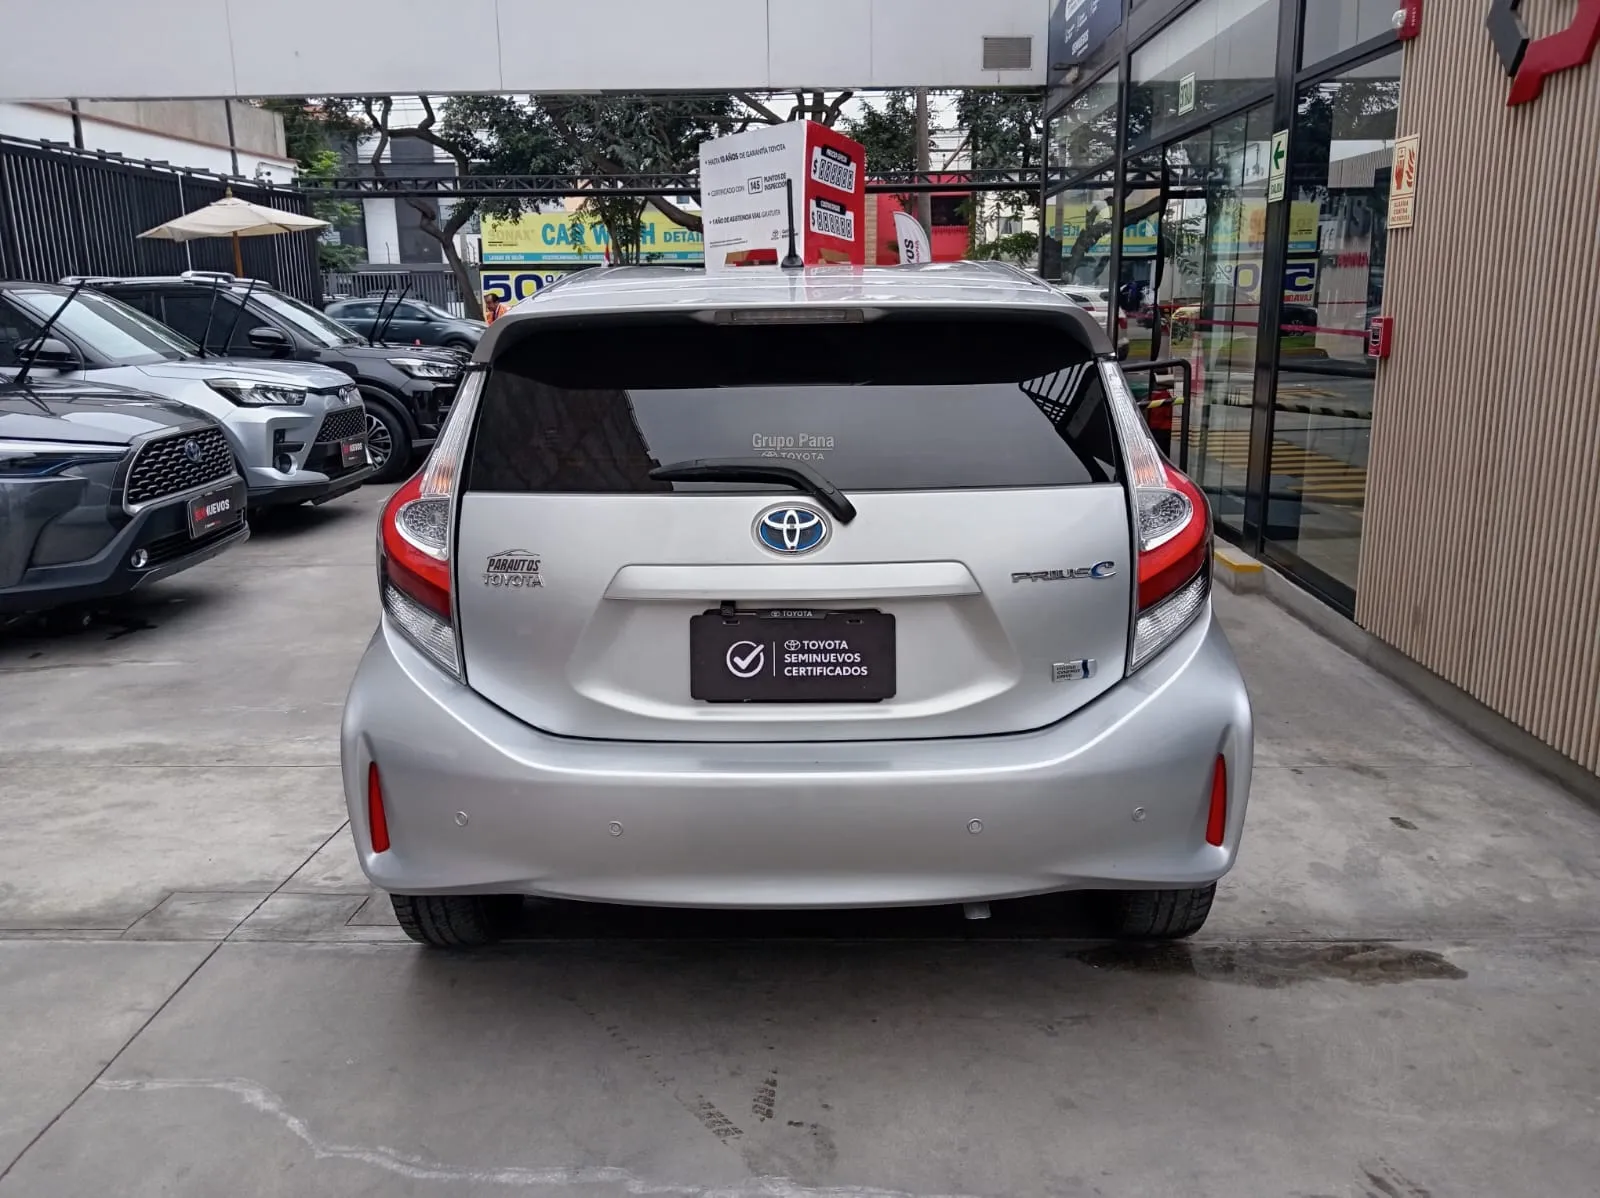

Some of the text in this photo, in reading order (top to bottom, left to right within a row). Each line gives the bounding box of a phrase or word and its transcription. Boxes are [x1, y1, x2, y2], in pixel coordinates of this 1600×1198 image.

[725, 152, 739, 162] AÑOS
[768, 143, 786, 153] TOYOTA
[764, 174, 780, 183] PUNTOS
[750, 180, 761, 190] 145
[541, 223, 586, 246] CAR
[592, 222, 656, 246] WH
[752, 432, 835, 451] Grupo Pana
[780, 452, 825, 461] TOYOTA
[486, 558, 541, 574] PARAUTOS
[482, 573, 546, 588] TOYOTA
[1011, 567, 1091, 583] PRIUS
[782, 610, 813, 618] TOYOTA
[802, 640, 849, 650] TOYOTA
[784, 653, 861, 663] SEMINUEVOS
[784, 666, 868, 677] CERTIFICADOS
